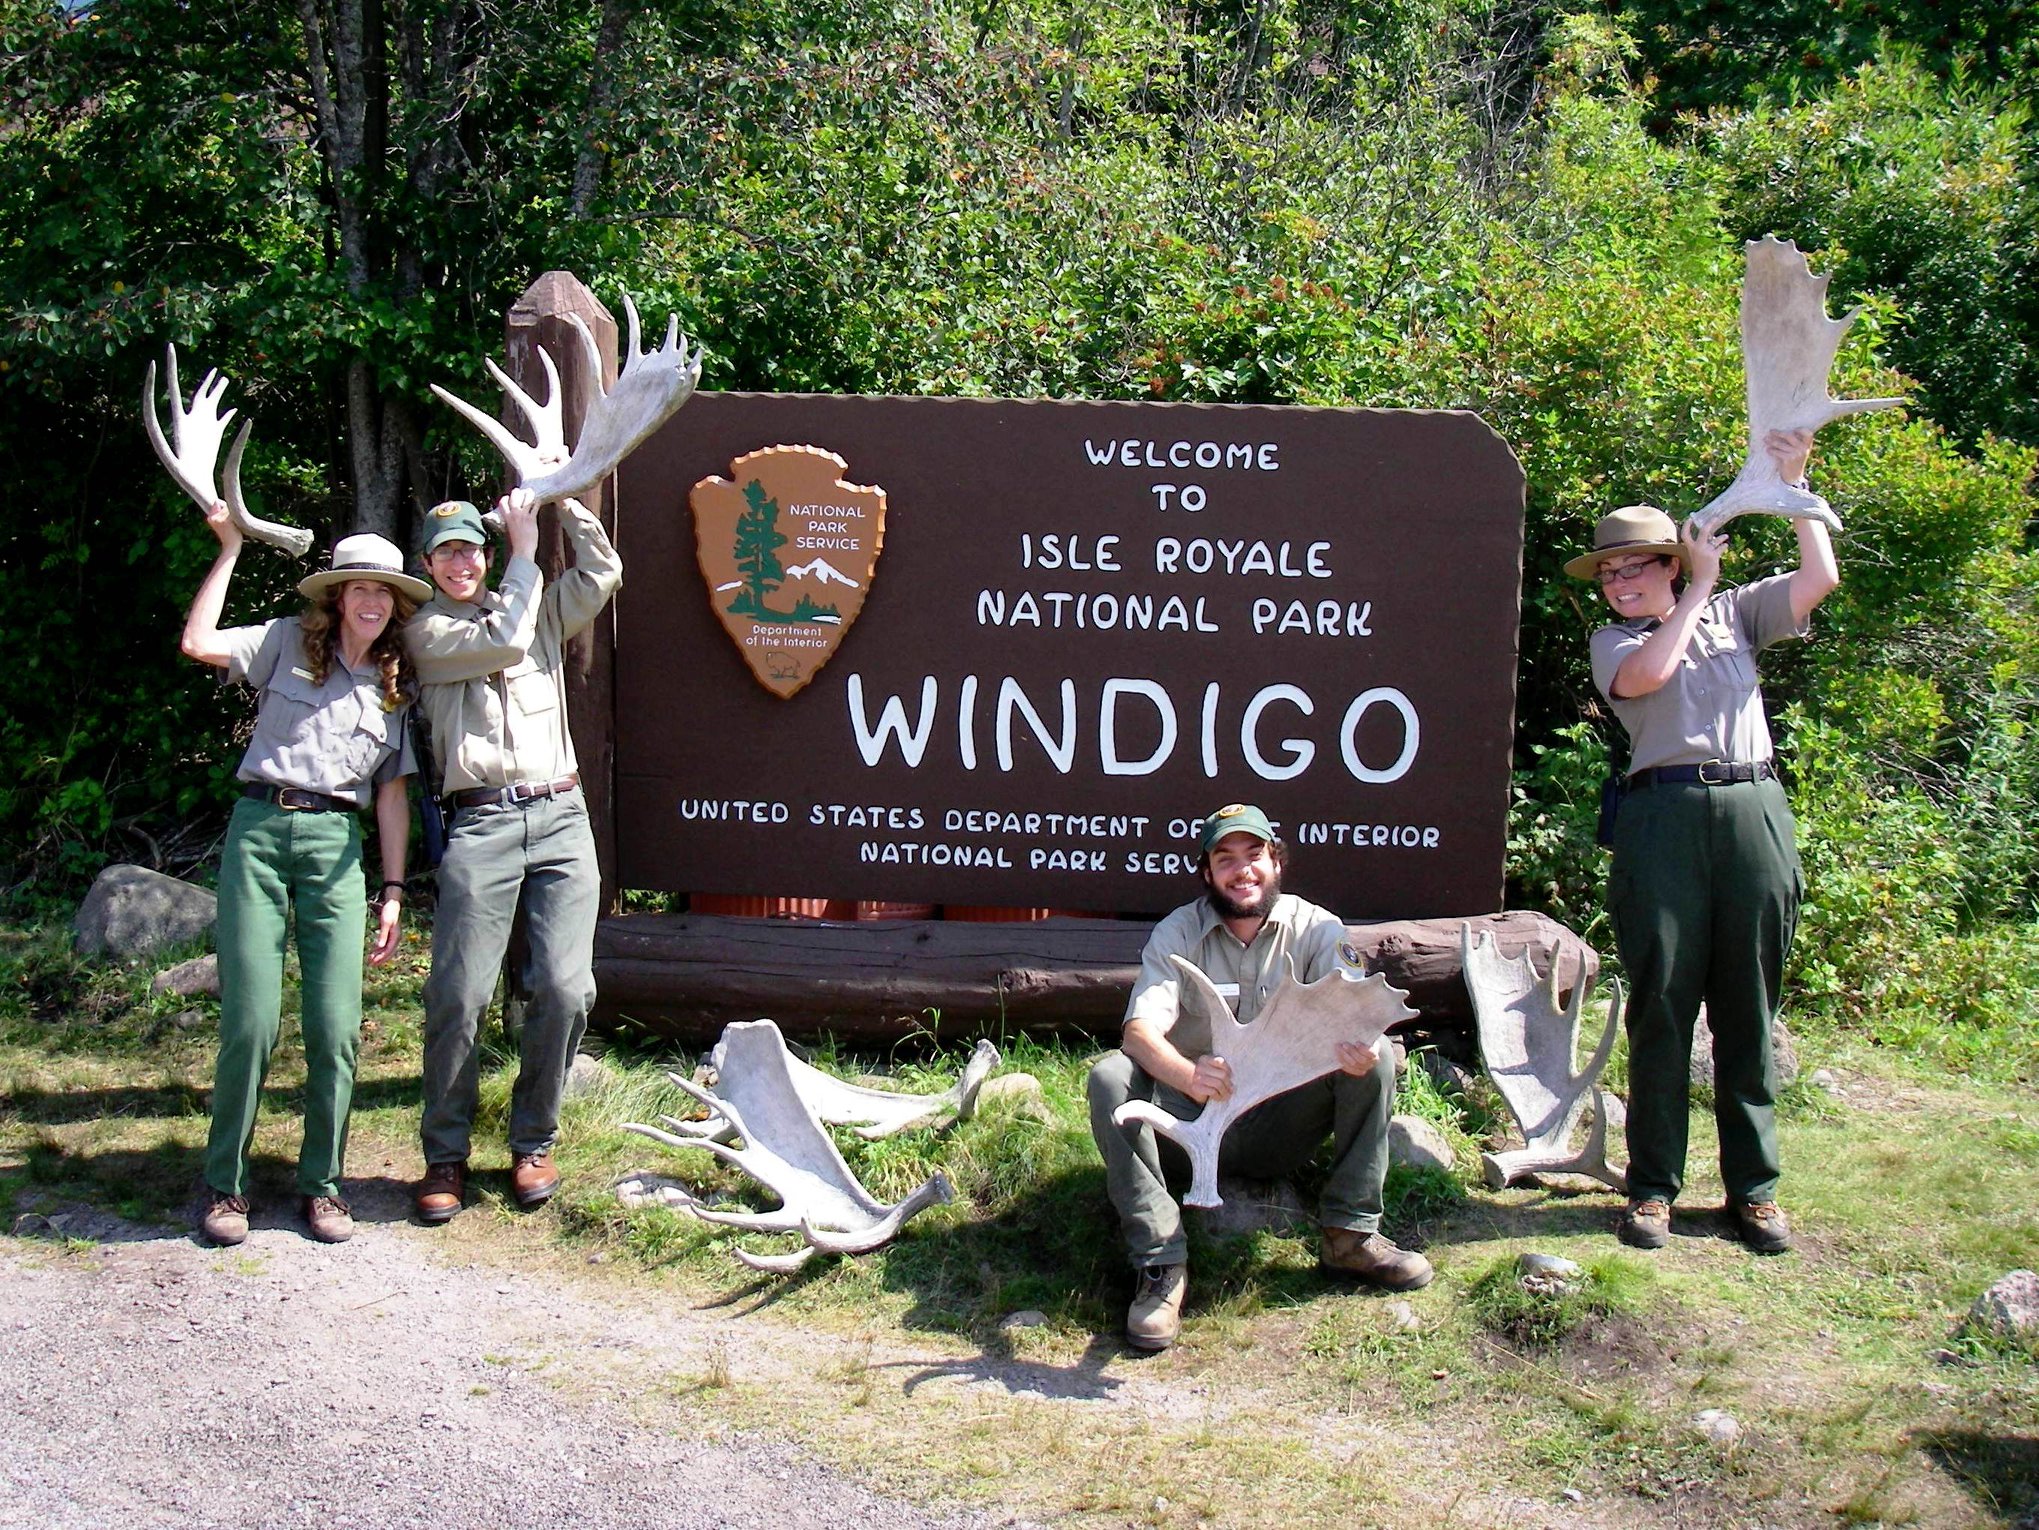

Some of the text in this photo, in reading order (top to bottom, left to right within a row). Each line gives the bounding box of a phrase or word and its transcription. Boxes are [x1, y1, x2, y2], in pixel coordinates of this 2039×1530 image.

[1084, 439, 1279, 471] WELCOME
[789, 504, 866, 518] NATIONAL
[1151, 484, 1207, 512] TO
[808, 520, 848, 533] PARK
[795, 537, 860, 550] SERVICE
[1022, 533, 1333, 578] ISLE ROYALE
[977, 589, 1373, 637] NATIONAL PARK
[745, 635, 828, 648] of the Interior
[752, 625, 822, 637] Department
[847, 673, 1420, 785] WINDIGO
[681, 799, 789, 823] UNITED
[809, 804, 925, 829] STATES
[945, 809, 1150, 838] DEPARTMENT
[1168, 818, 1205, 839] OF
[1298, 823, 1440, 848] INTERIOR
[860, 841, 1013, 868] NATIONAL
[1030, 848, 1107, 872] PARK
